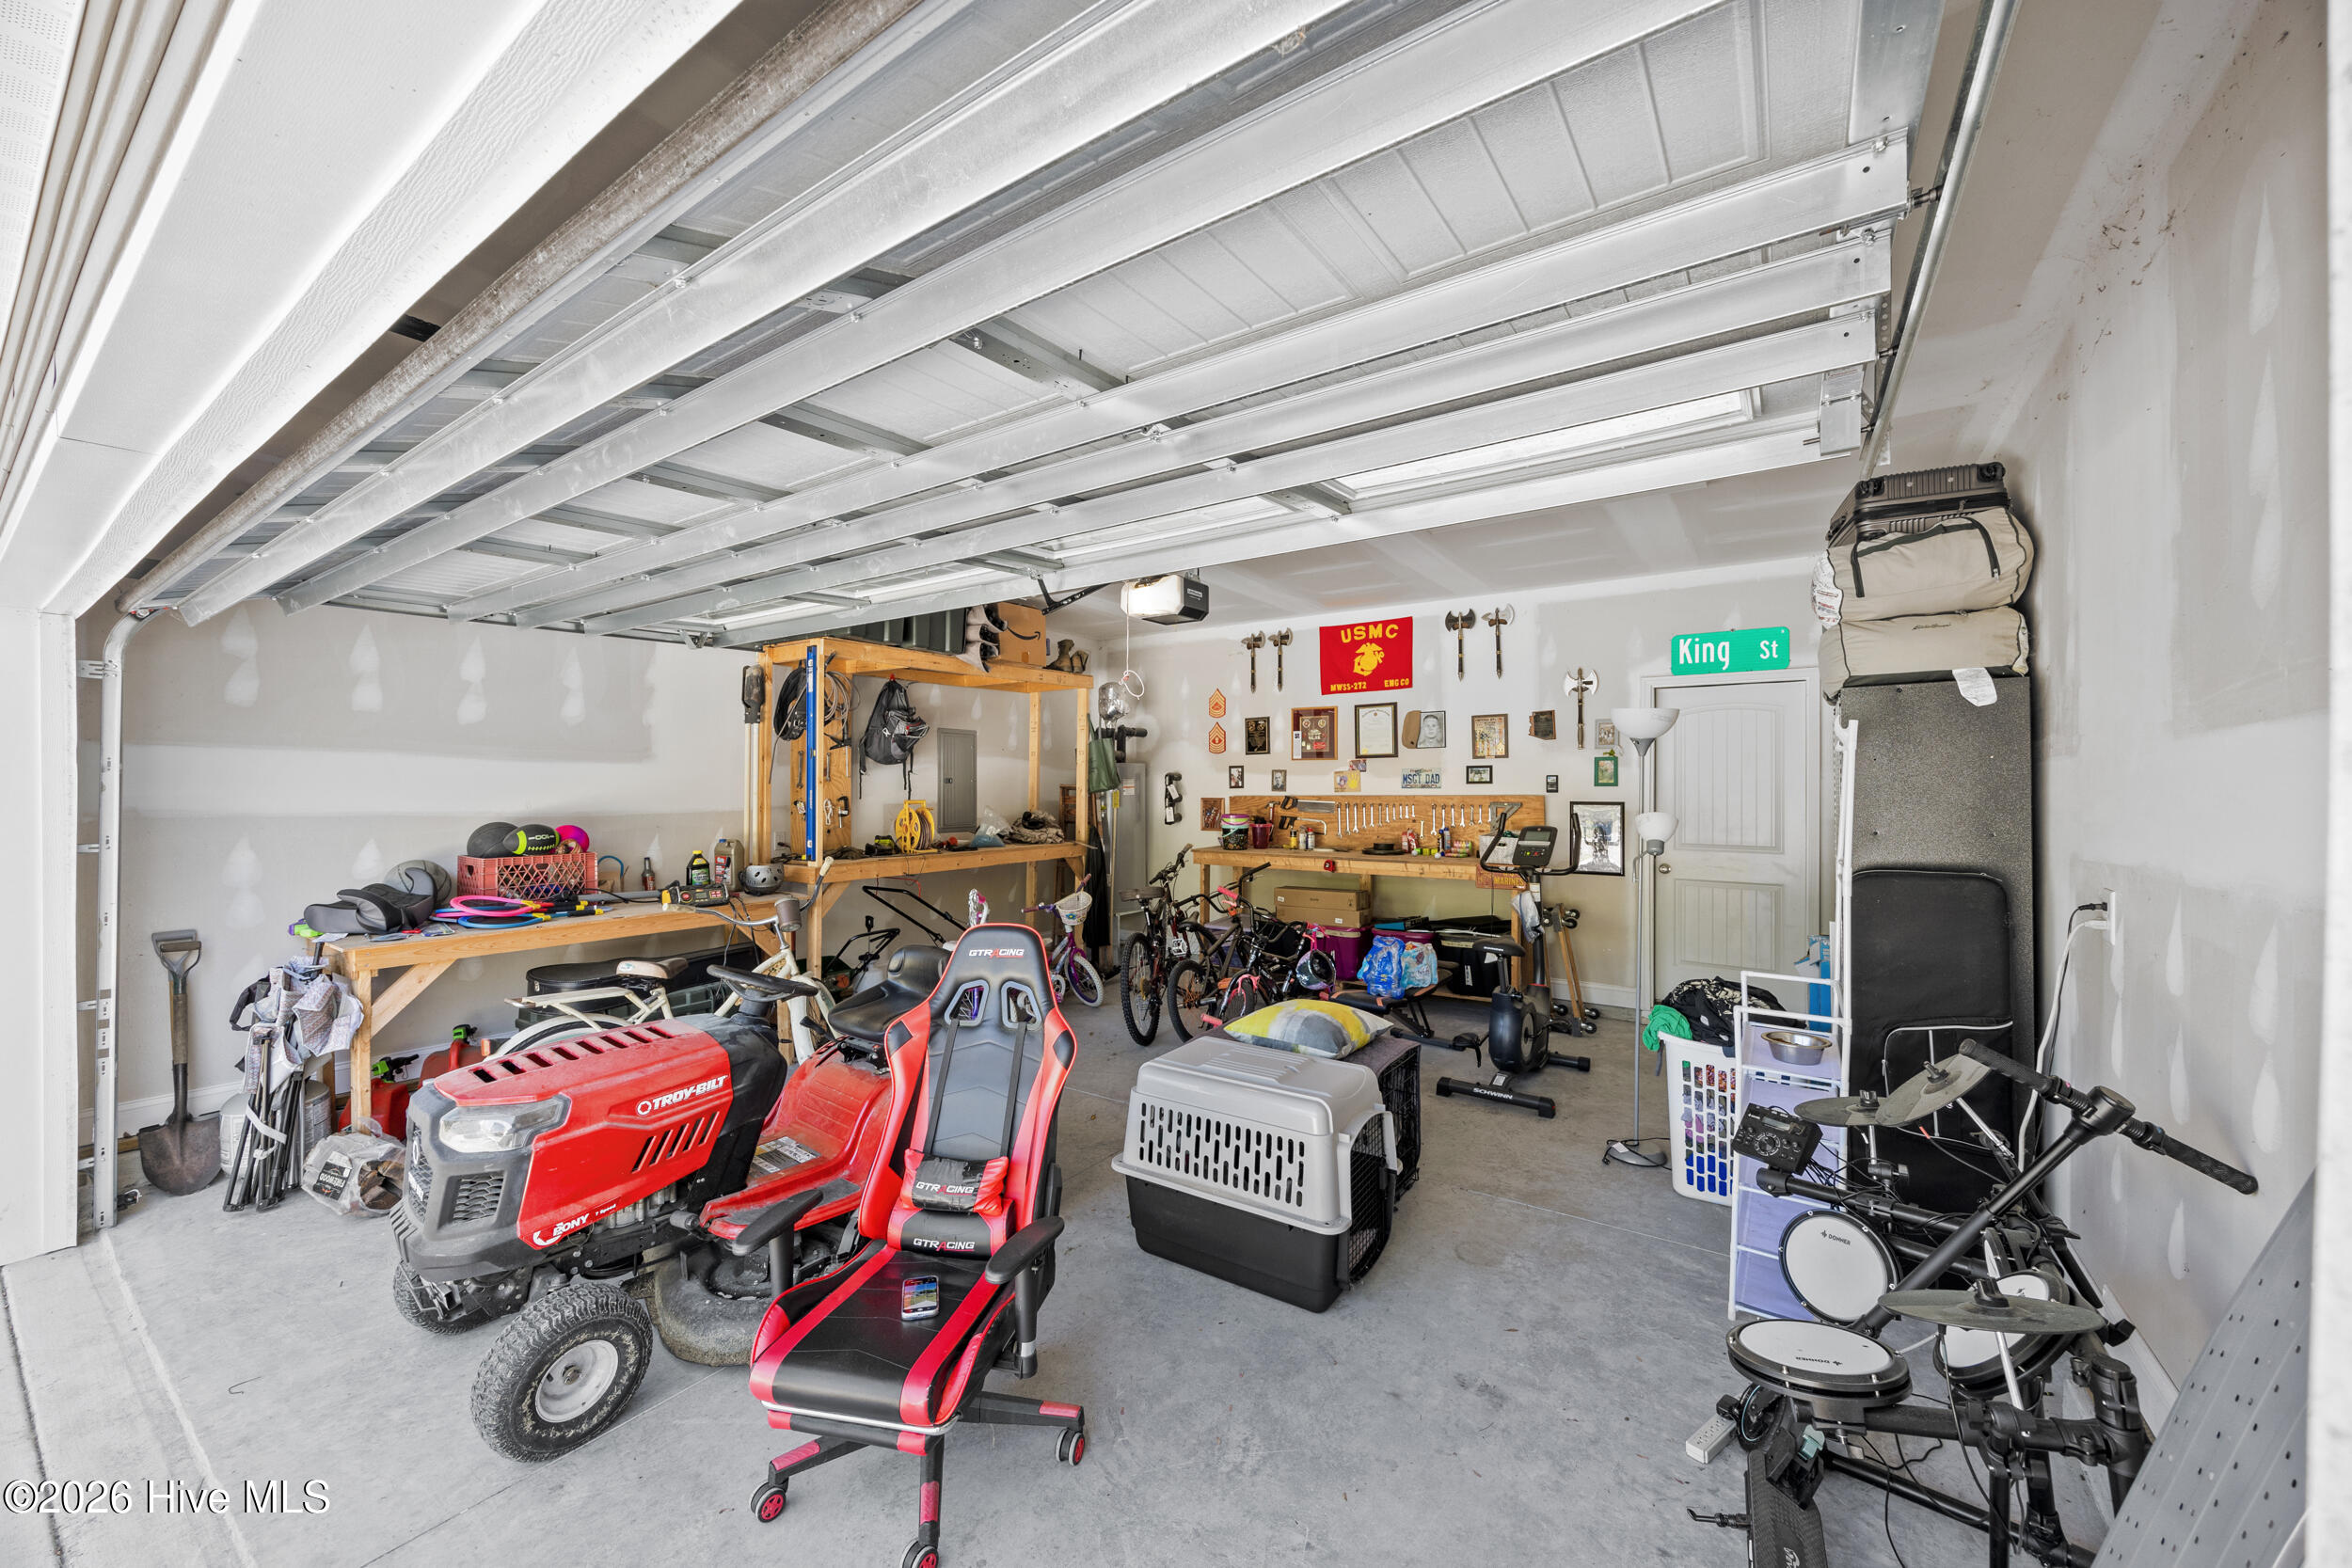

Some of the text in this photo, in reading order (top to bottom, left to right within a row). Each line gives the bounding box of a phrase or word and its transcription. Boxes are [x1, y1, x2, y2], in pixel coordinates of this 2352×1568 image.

[1340, 624, 1399, 643] USMC
[1678, 638, 1779, 671] King St
[1329, 681, 1367, 692] MWSS-272
[1424, 773, 1440, 784] DAD
[1493, 876, 1524, 887] MARINES
[968, 948, 1025, 958] GTRACING
[652, 1074, 729, 1111] TROY-BILT
[319, 1172, 346, 1188] FIREWOOD
[915, 1181, 975, 1196] GTRACING
[552, 1212, 590, 1237] PONY
[913, 1237, 976, 1252] GTRACING
[1828, 1233, 1851, 1246] DONNER
